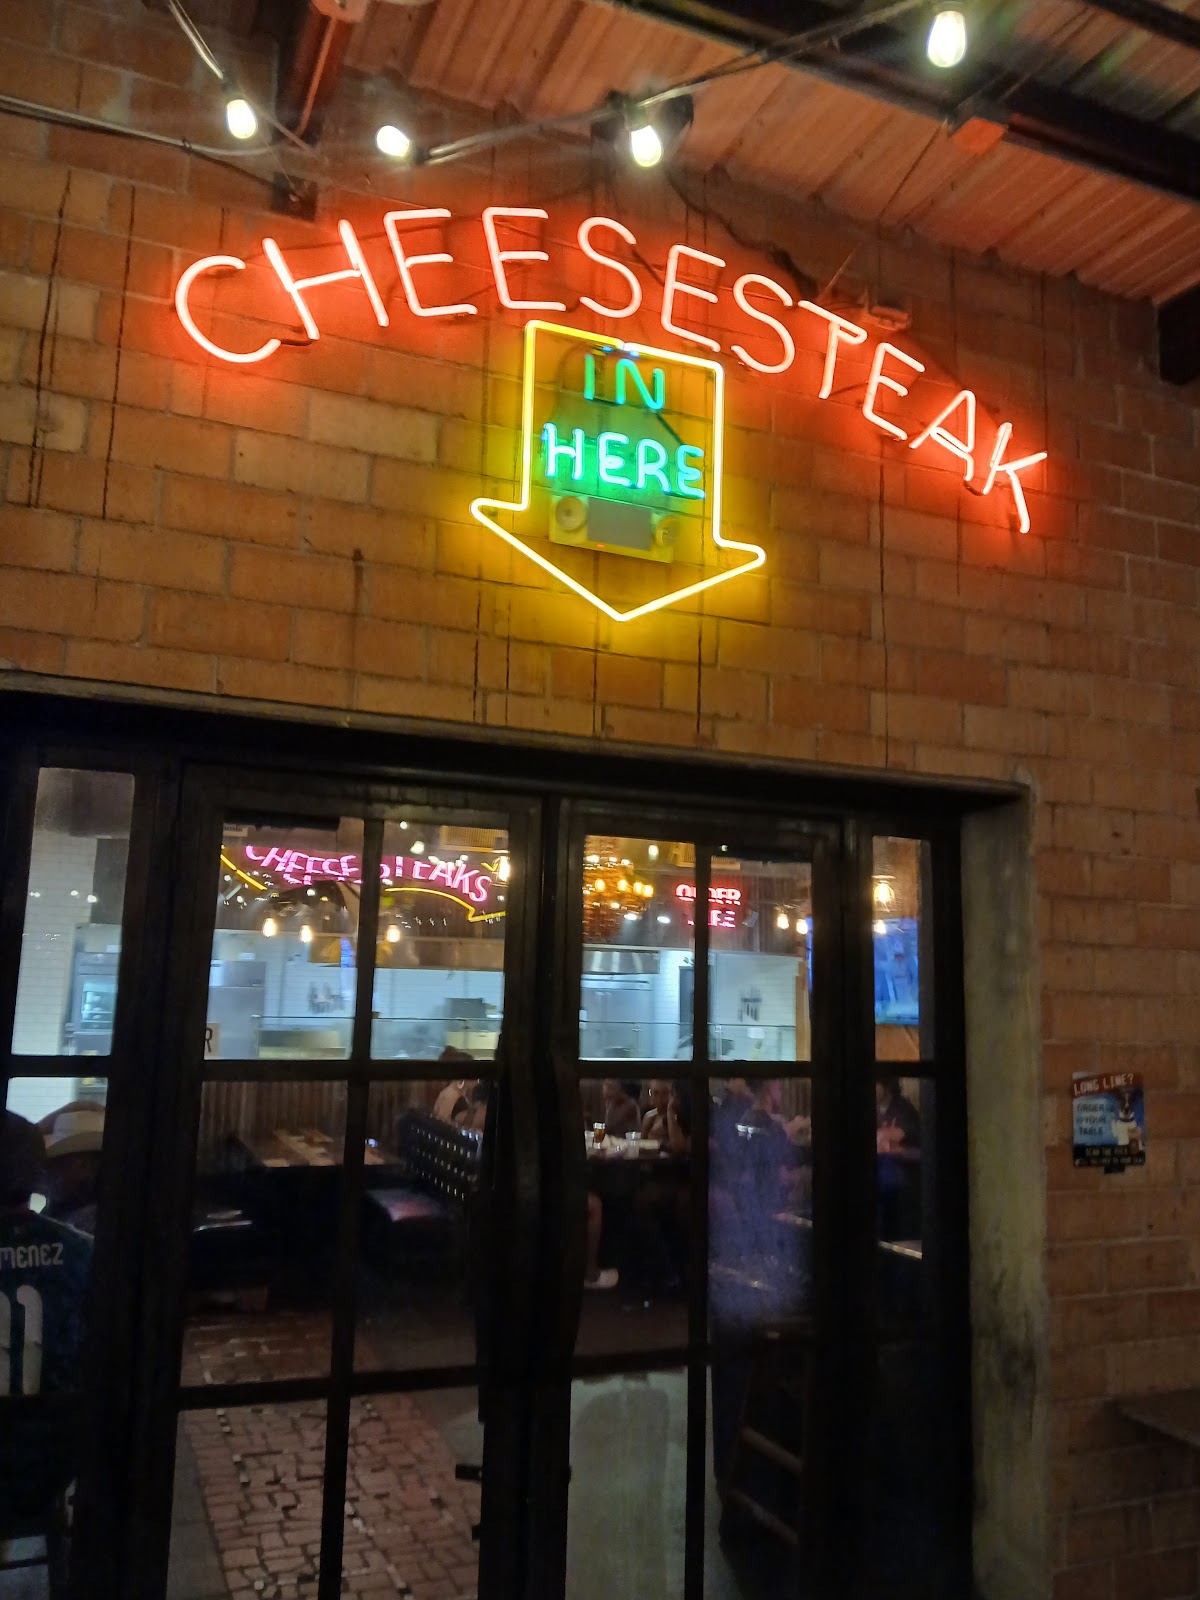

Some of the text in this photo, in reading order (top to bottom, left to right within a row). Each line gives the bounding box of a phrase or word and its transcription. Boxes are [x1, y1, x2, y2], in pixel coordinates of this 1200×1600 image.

[174, 206, 1050, 536] CHEESESTEAK
[583, 352, 667, 411] IN
[541, 421, 707, 501] HERE
[1073, 1073, 1134, 1096] LONG LINE?
